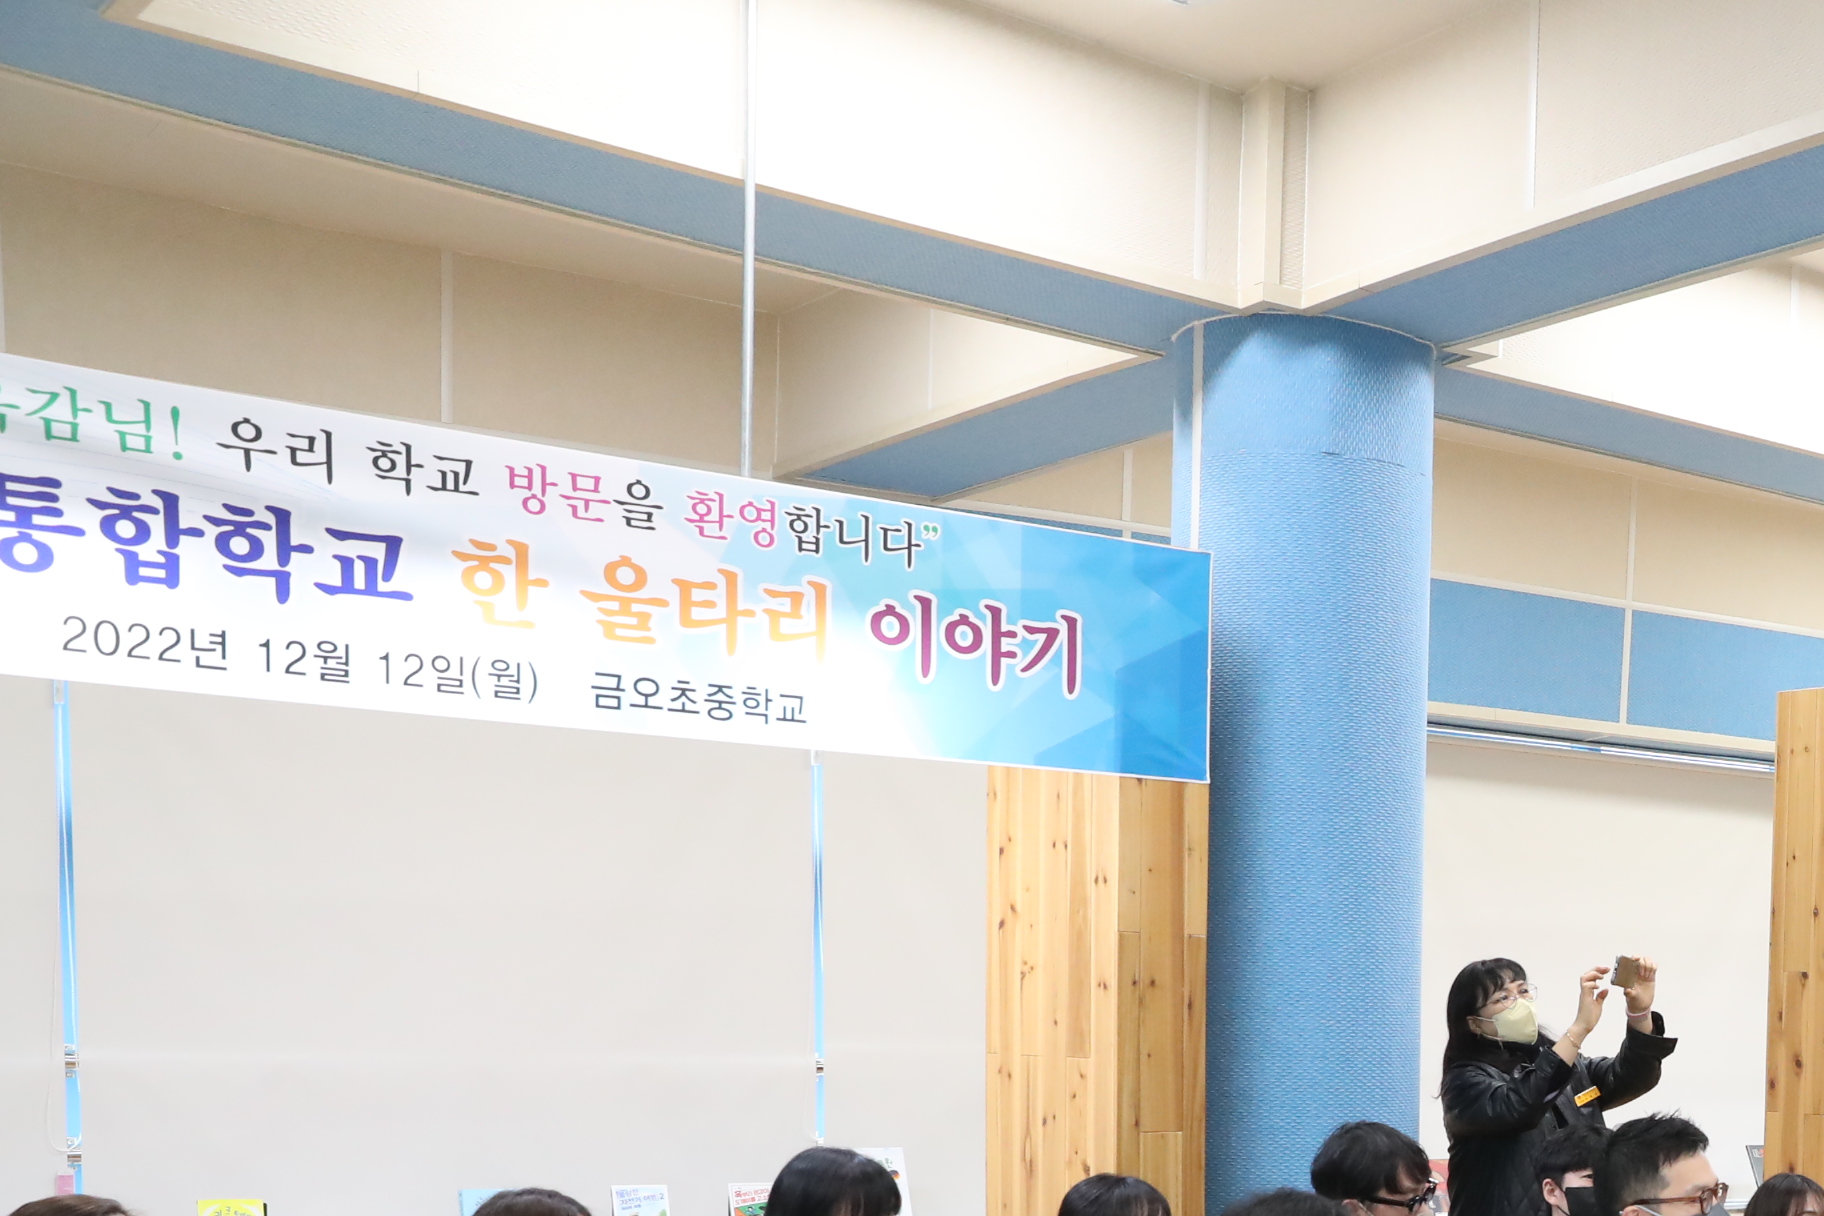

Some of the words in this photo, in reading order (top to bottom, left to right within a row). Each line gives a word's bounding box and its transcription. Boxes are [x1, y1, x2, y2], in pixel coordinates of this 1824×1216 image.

[0, 384, 183, 461] 감님!
[216, 417, 333, 485] 우리
[366, 441, 480, 497] 학교
[505, 463, 664, 531] 방문을
[0, 472, 414, 605] 통합학교
[451, 538, 549, 629] 한
[580, 554, 828, 662] 울타리
[870, 594, 1081, 695] 이야기
[62, 615, 228, 671] 2022년
[258, 639, 351, 684] 12월
[379, 652, 538, 704] 12일(월)
[591, 671, 807, 724] 금오초중학교
